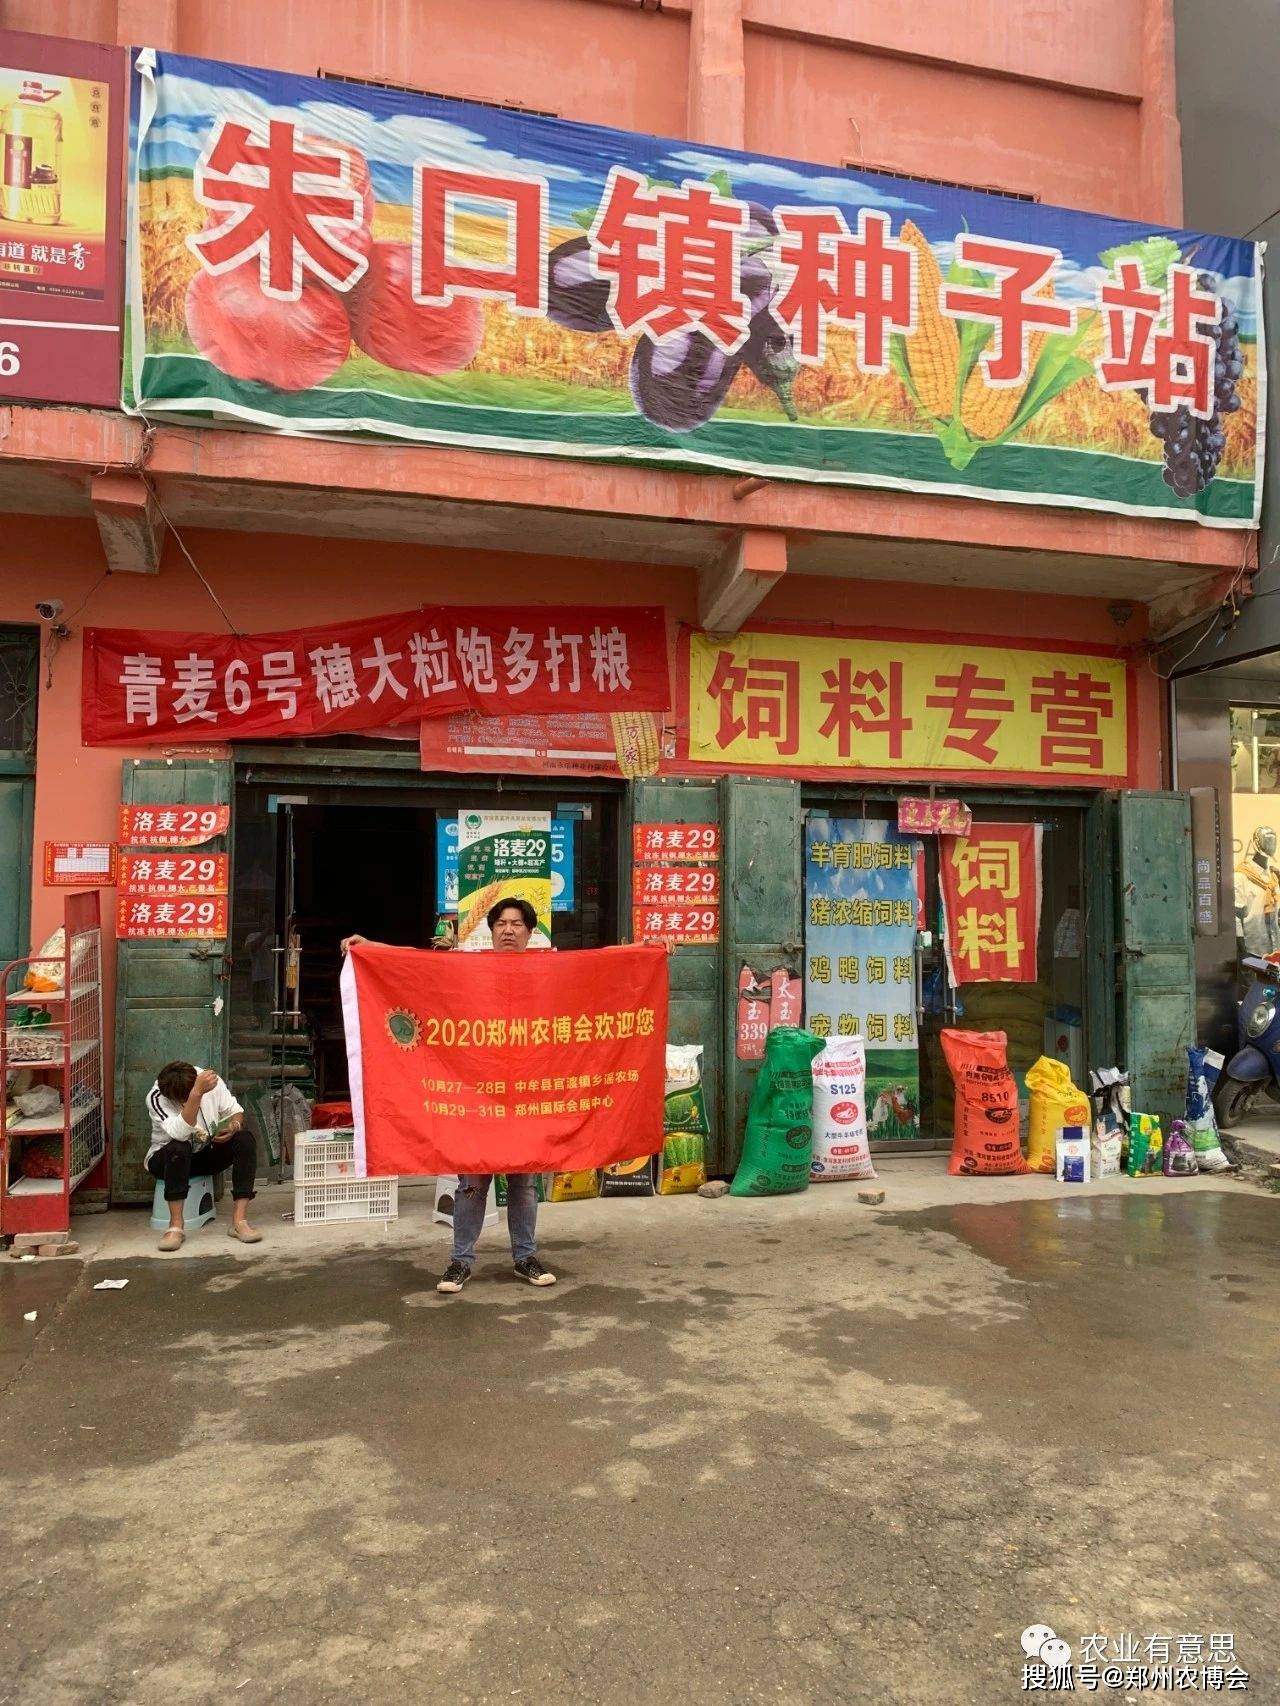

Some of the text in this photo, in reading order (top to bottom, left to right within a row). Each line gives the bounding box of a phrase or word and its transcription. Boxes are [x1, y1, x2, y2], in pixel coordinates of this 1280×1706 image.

[188, 113, 1221, 418] 朱口镇种子站
[0, 341, 20, 376] 6
[119, 626, 633, 726] 青麦6号穗大粒饱多打粮
[706, 650, 1114, 769] 饲料专营
[133, 811, 217, 832] 洛麦29
[494, 839, 546, 857] 洛麦29
[646, 829, 716, 849] 洛麦29
[811, 842, 914, 870] 羊育肥饲料
[131, 859, 216, 881] 洛麦29
[645, 873, 715, 892] 洛麦29
[130, 902, 215, 924] 洛麦29
[811, 899, 914, 926] 猪浓缩饲料
[951, 837, 1025, 970] 饲料
[645, 911, 715, 931] 洛麦29
[810, 956, 912, 984] 鸡鸭饲料
[426, 1007, 655, 1047] 2020郑州农博会欢迎您
[810, 1014, 914, 1041] 宠物饲料
[830, 1083, 857, 1095] S125
[981, 1091, 1009, 1103] 8510
[514, 1095, 614, 1116] 郑州国际会展中心
